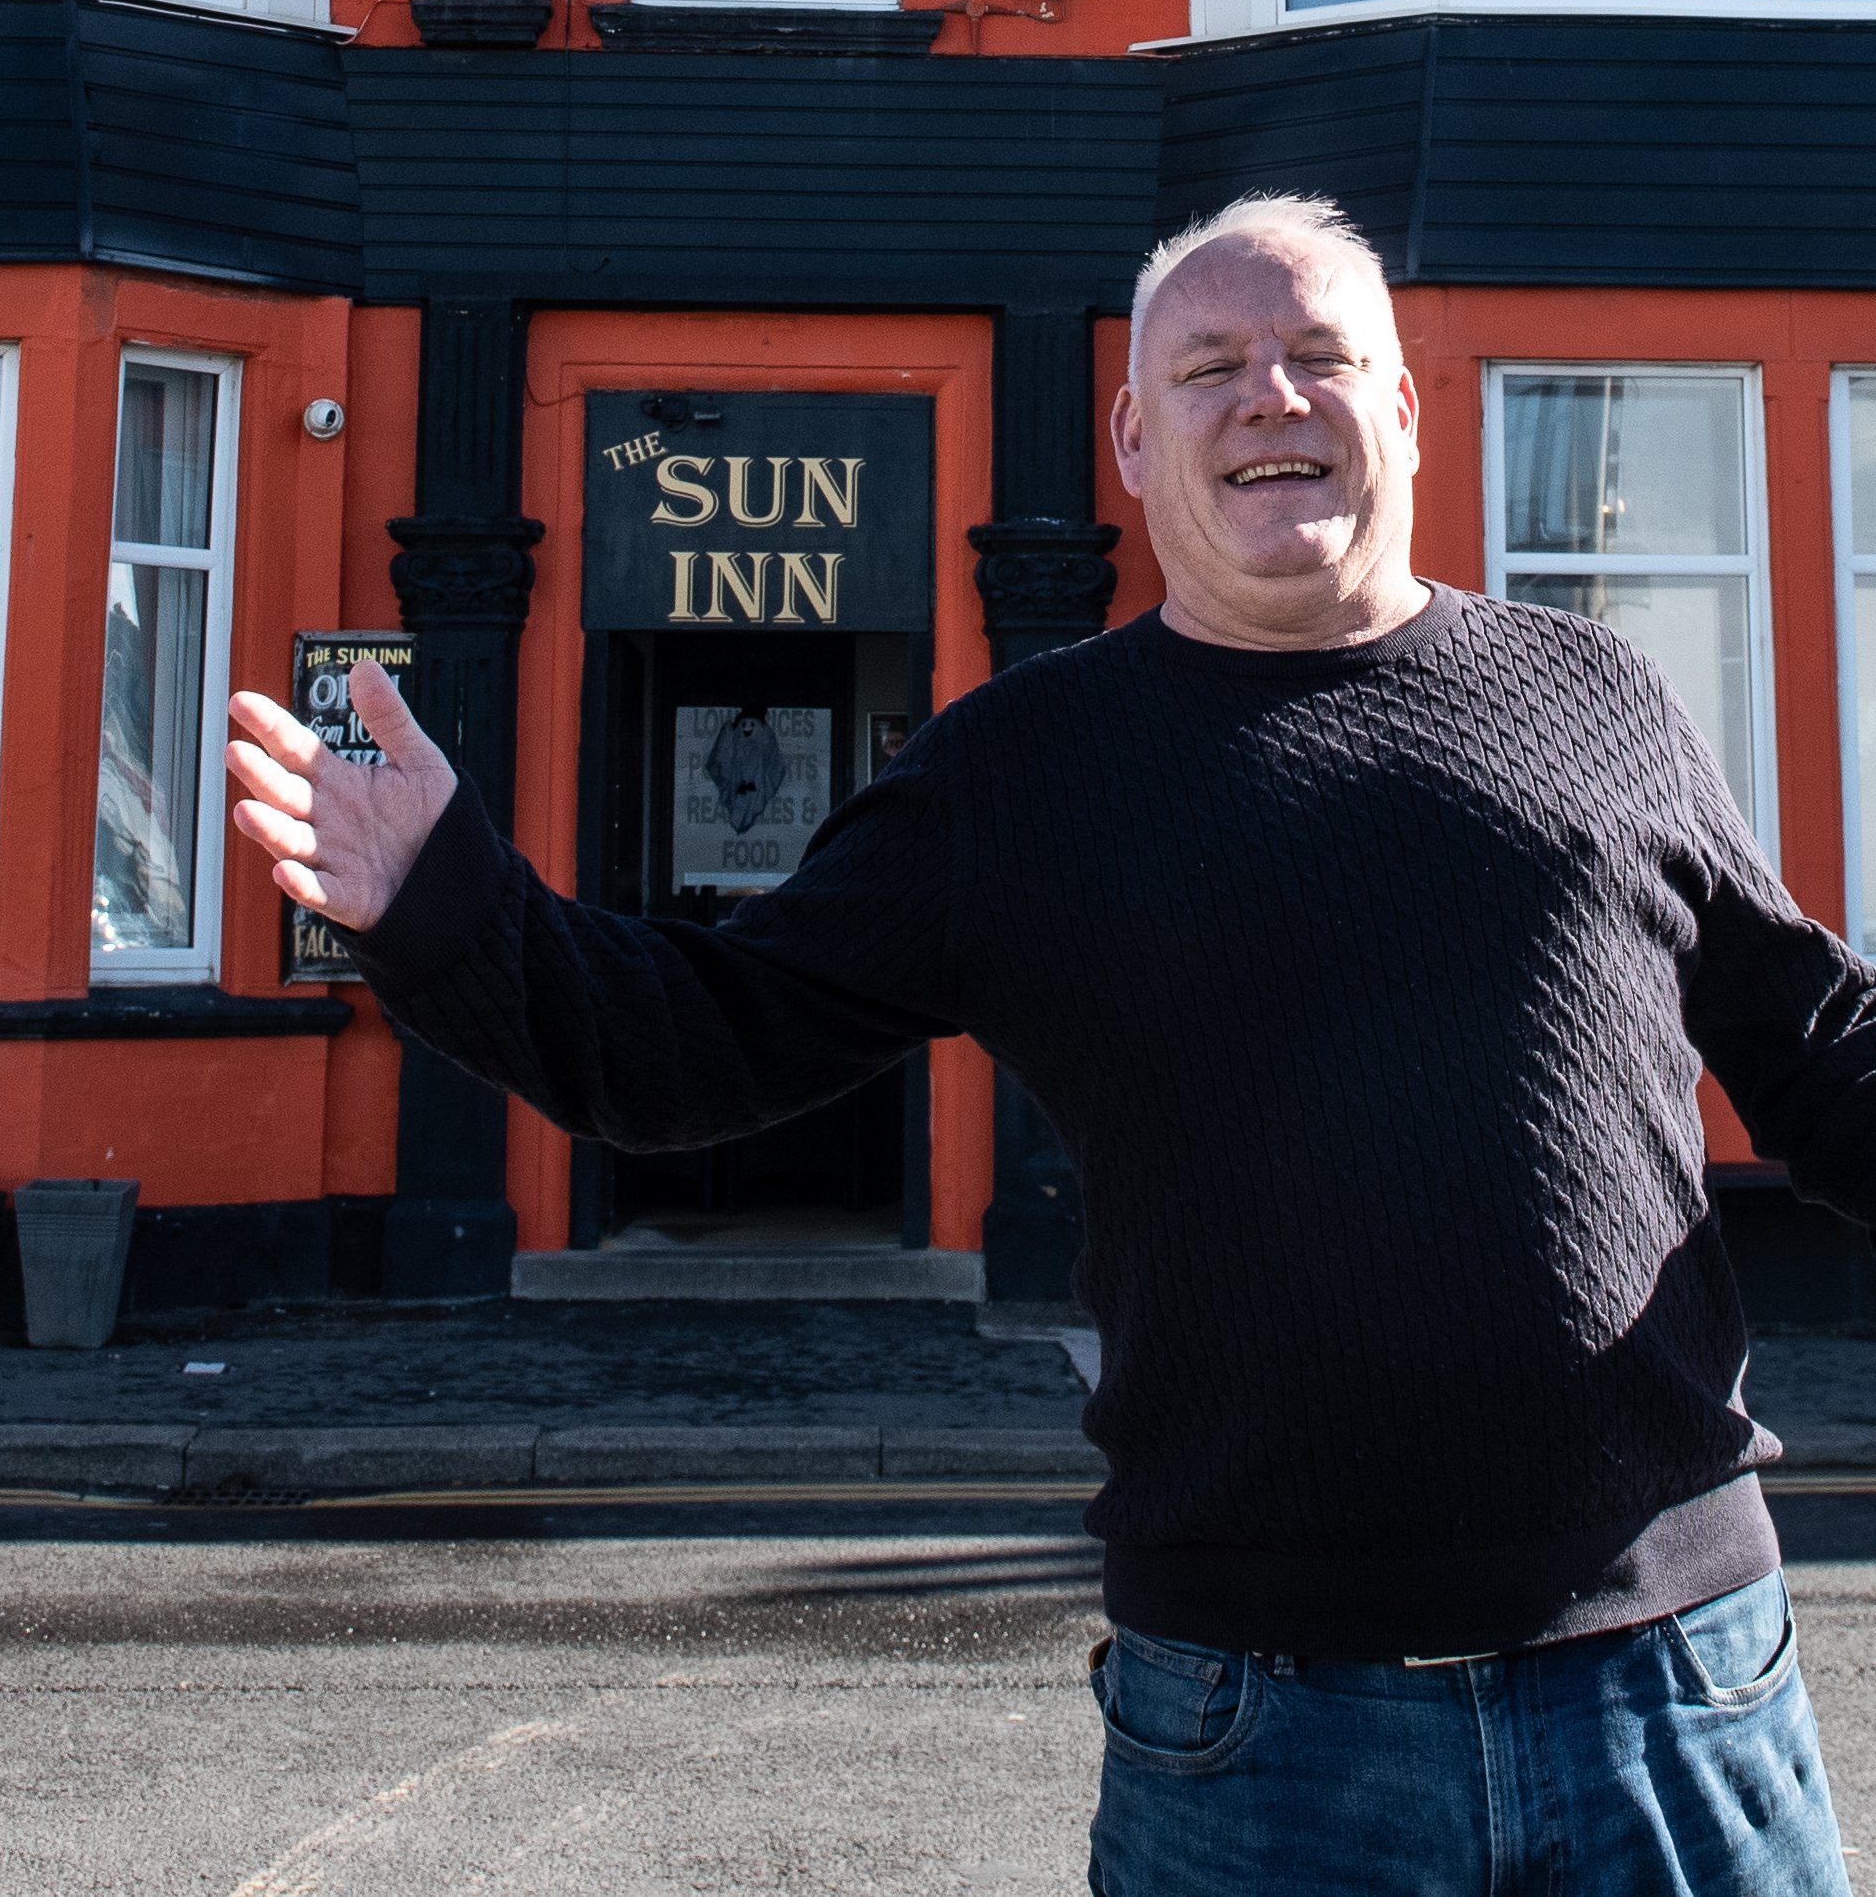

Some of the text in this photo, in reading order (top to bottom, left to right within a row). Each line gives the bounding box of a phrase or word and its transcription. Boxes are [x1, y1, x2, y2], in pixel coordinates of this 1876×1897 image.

[602, 430, 669, 472] THE
[650, 454, 867, 529] SUN
[667, 550, 847, 625] INN
[306, 646, 412, 669] THE SUN INN
[309, 674, 401, 711] OP
[687, 795, 730, 825] REA
[801, 796, 818, 826] &
[722, 839, 781, 869] FOOD
[293, 923, 351, 959] FACE
